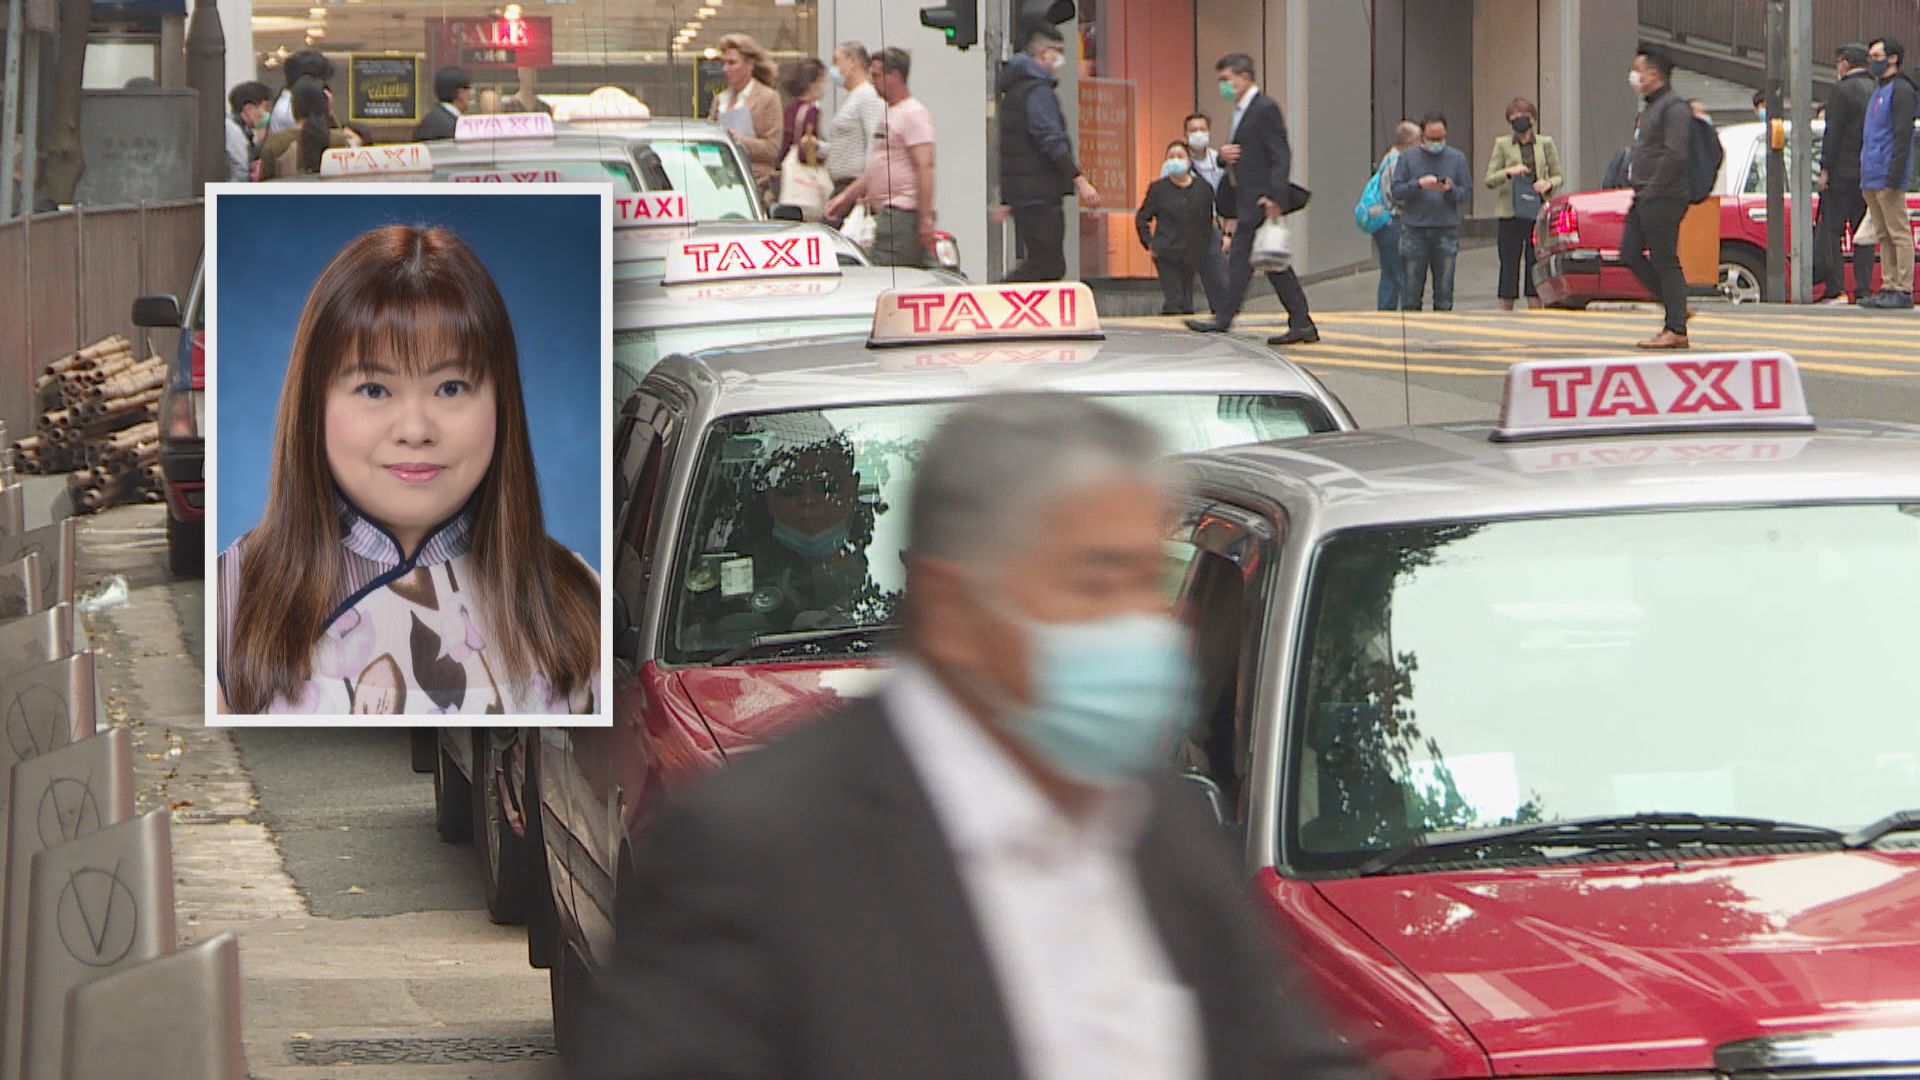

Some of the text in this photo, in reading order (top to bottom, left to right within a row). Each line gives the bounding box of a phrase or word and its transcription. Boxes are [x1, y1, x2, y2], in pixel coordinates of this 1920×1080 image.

[450, 20, 529, 46] SALE
[463, 115, 545, 133] TAXI
[332, 146, 421, 171] TAXI
[615, 195, 684, 219] TAXI
[683, 236, 821, 272] TAXI
[896, 288, 1076, 333] TAXI
[1531, 358, 1780, 418] TAXI
